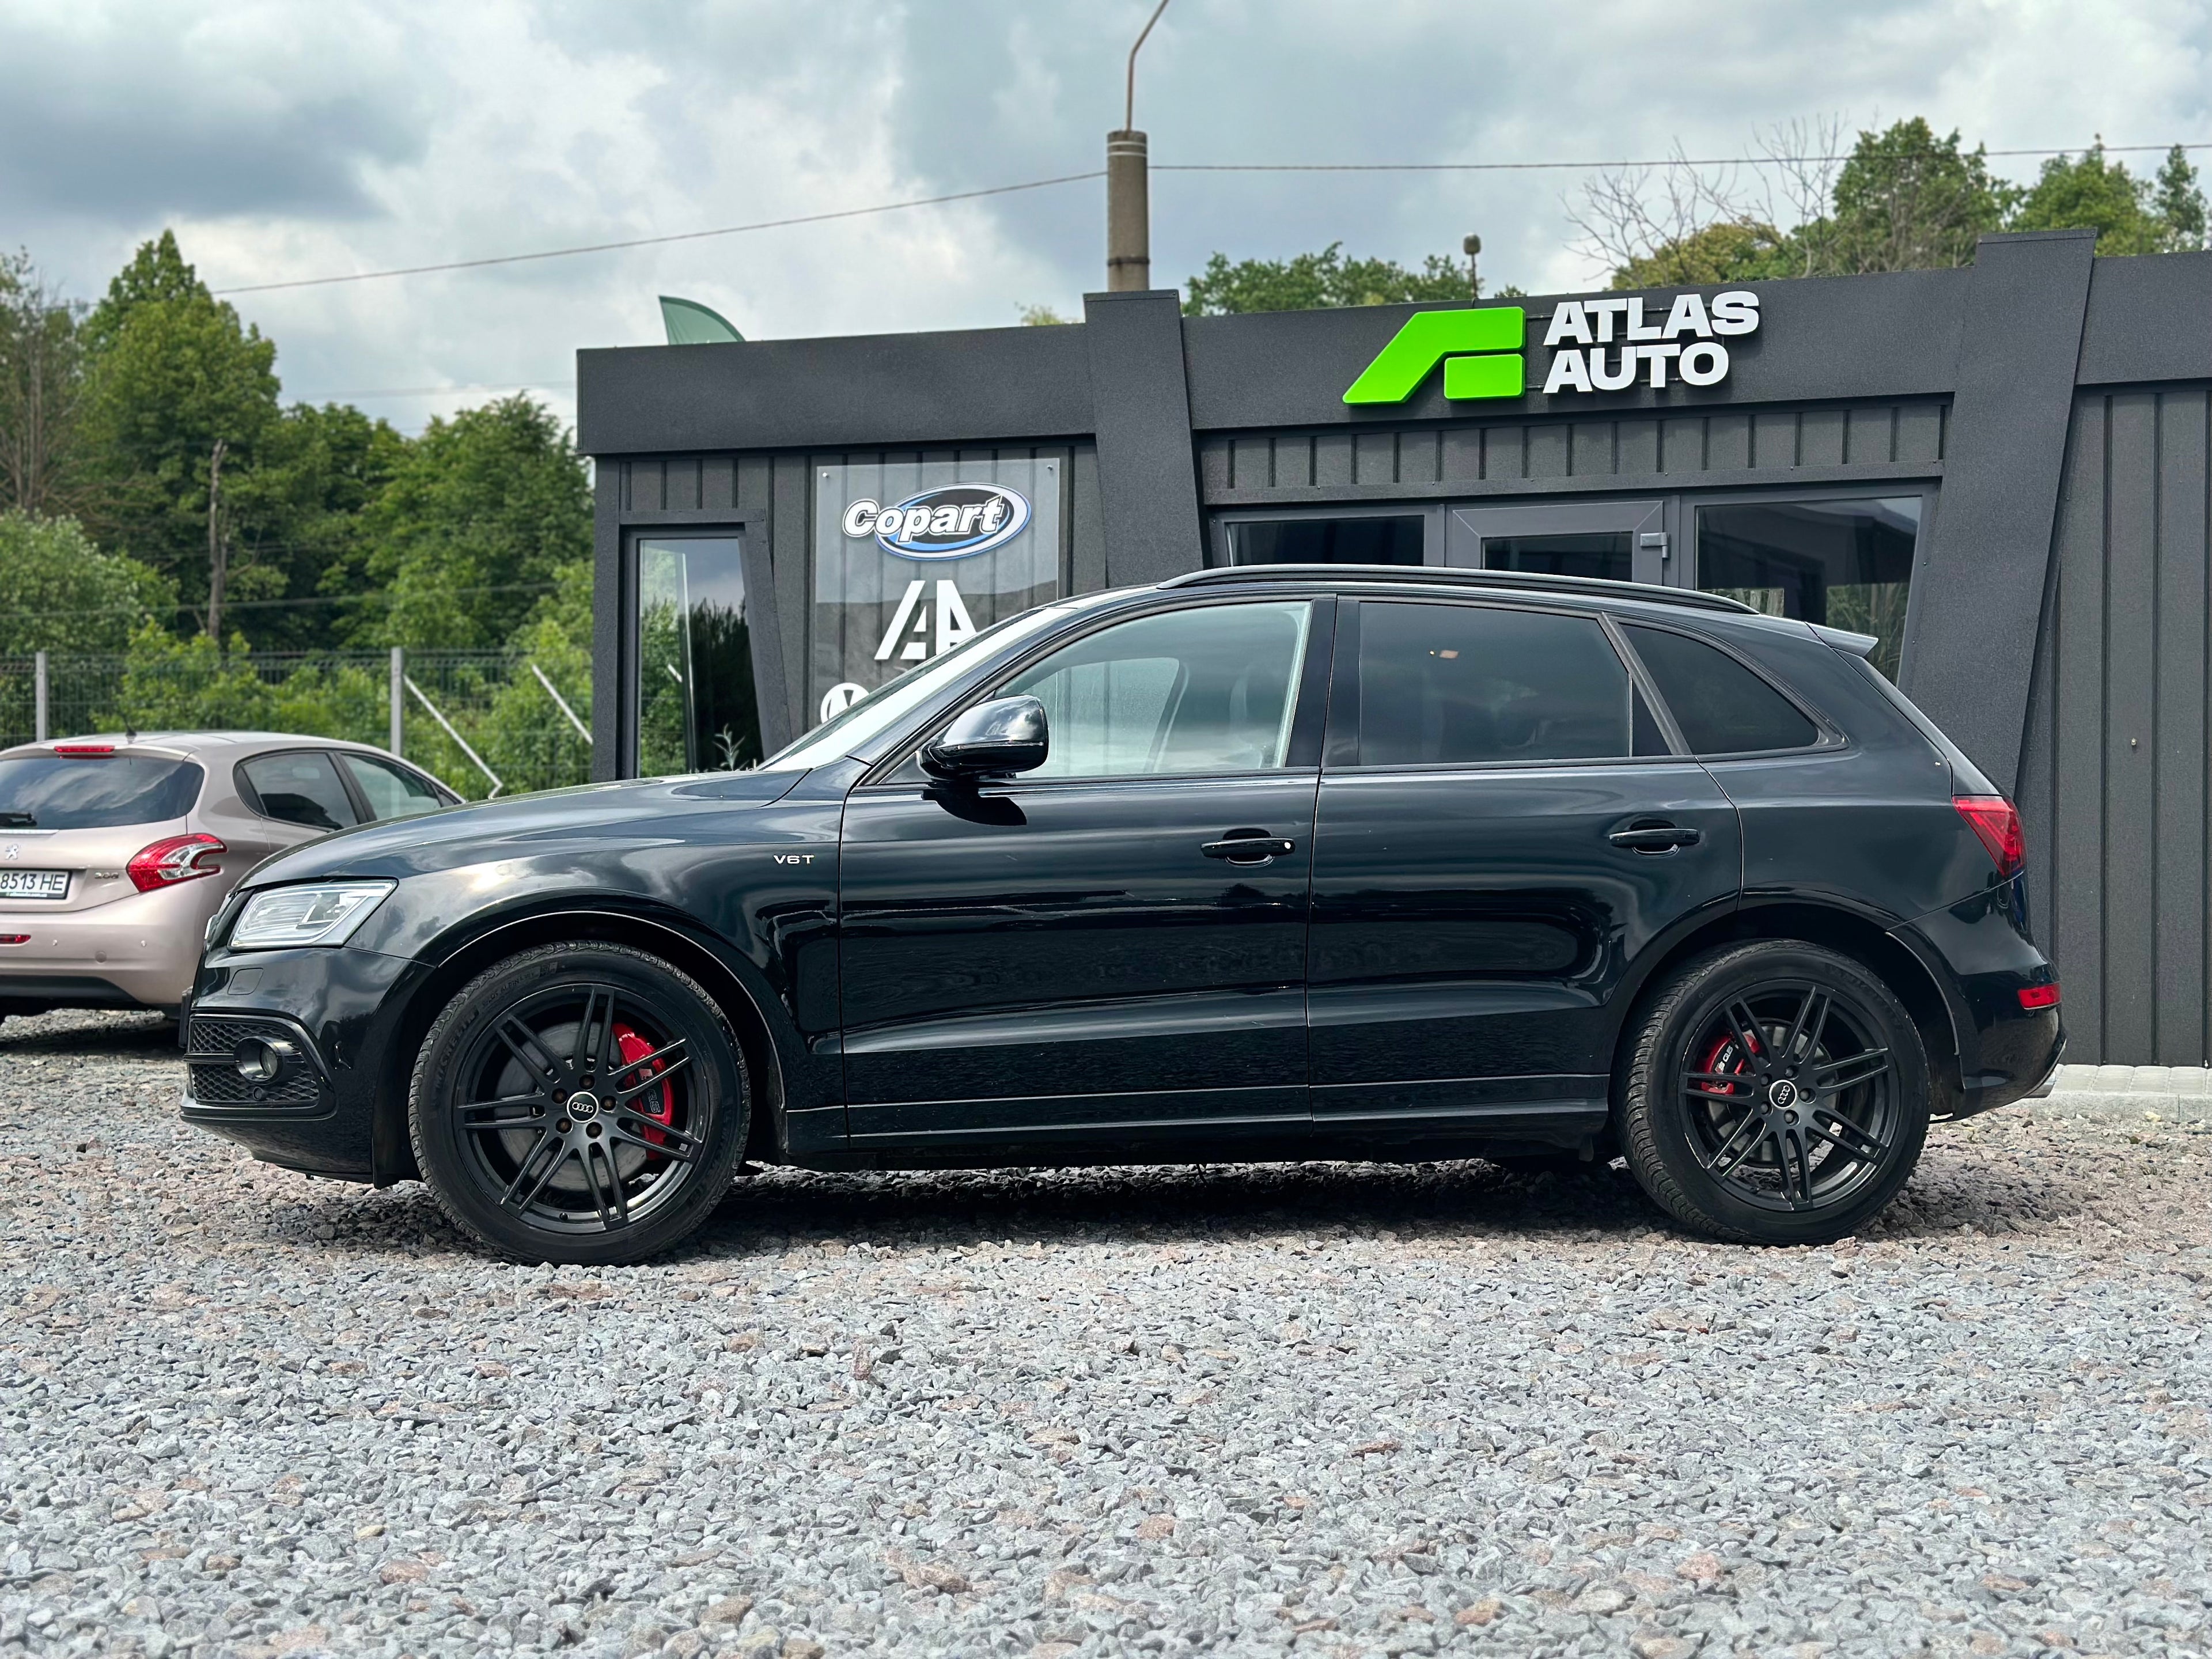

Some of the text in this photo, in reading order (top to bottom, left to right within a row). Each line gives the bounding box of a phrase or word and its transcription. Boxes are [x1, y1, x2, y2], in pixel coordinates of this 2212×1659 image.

[1543, 290, 1760, 345] ATLAS
[1543, 342, 1729, 393] AUTO
[842, 495, 1005, 543] Copart
[0, 873, 66, 891] 8513 HE
[773, 855, 815, 865] V6T
